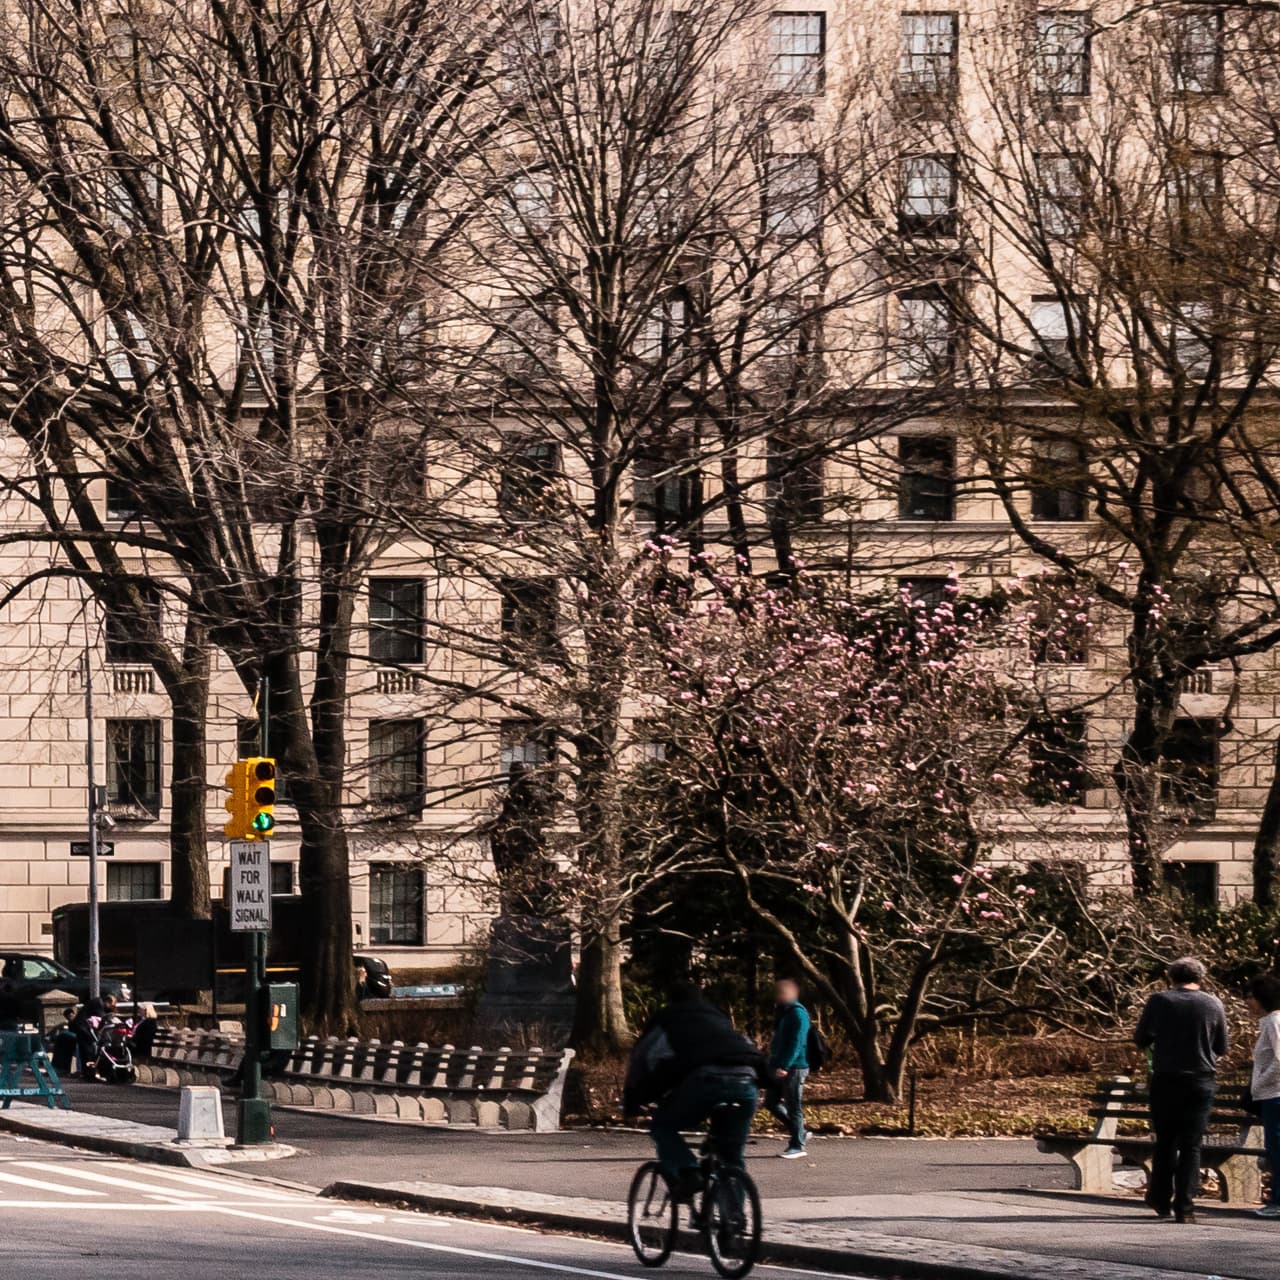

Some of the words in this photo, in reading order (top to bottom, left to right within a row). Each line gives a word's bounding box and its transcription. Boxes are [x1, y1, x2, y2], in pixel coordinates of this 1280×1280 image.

[238, 851, 262, 865] WAIT
[240, 871, 260, 884] FOR
[236, 889, 265, 904] WALK
[235, 908, 267, 922] SIGNAL
[0, 1088, 21, 1096] POLICE
